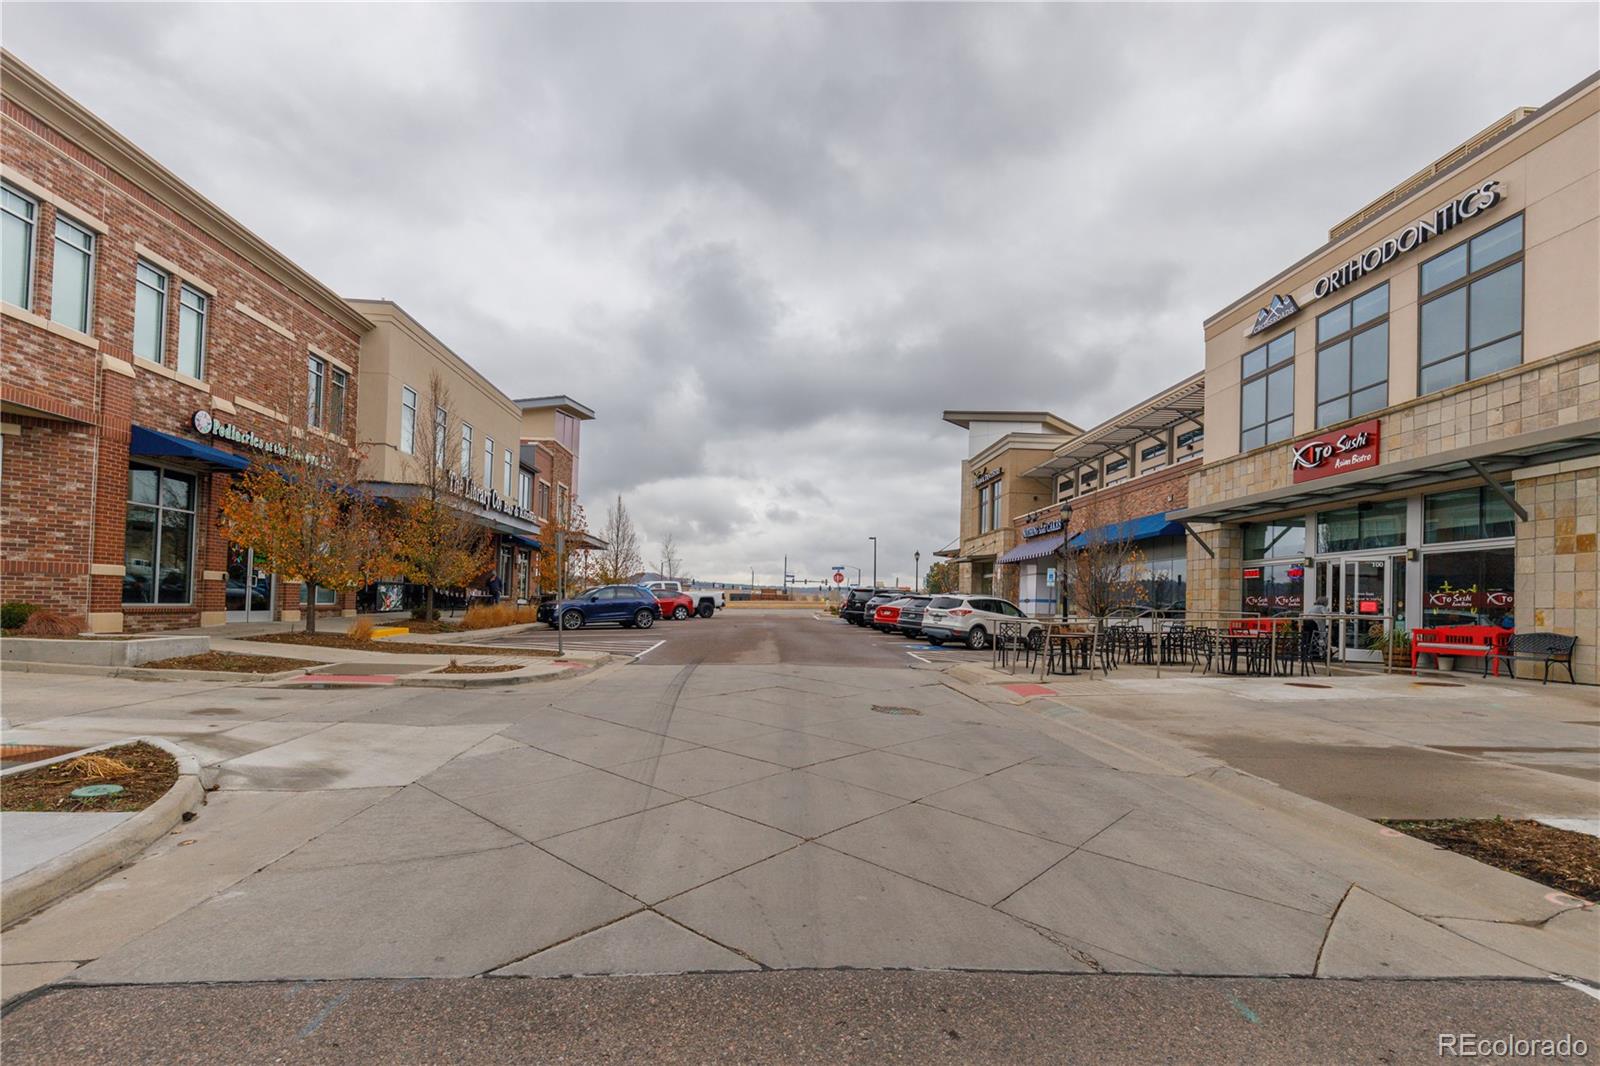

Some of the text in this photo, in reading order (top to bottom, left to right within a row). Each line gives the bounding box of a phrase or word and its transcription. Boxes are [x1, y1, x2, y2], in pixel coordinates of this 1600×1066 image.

[1313, 180, 1500, 299] ORTHODONTICS
[212, 418, 264, 449] Pediatrics
[1335, 432, 1368, 454] Sushi
[1351, 453, 1372, 466] Bistro
[448, 470, 464, 498] The
[464, 477, 491, 512] Library
